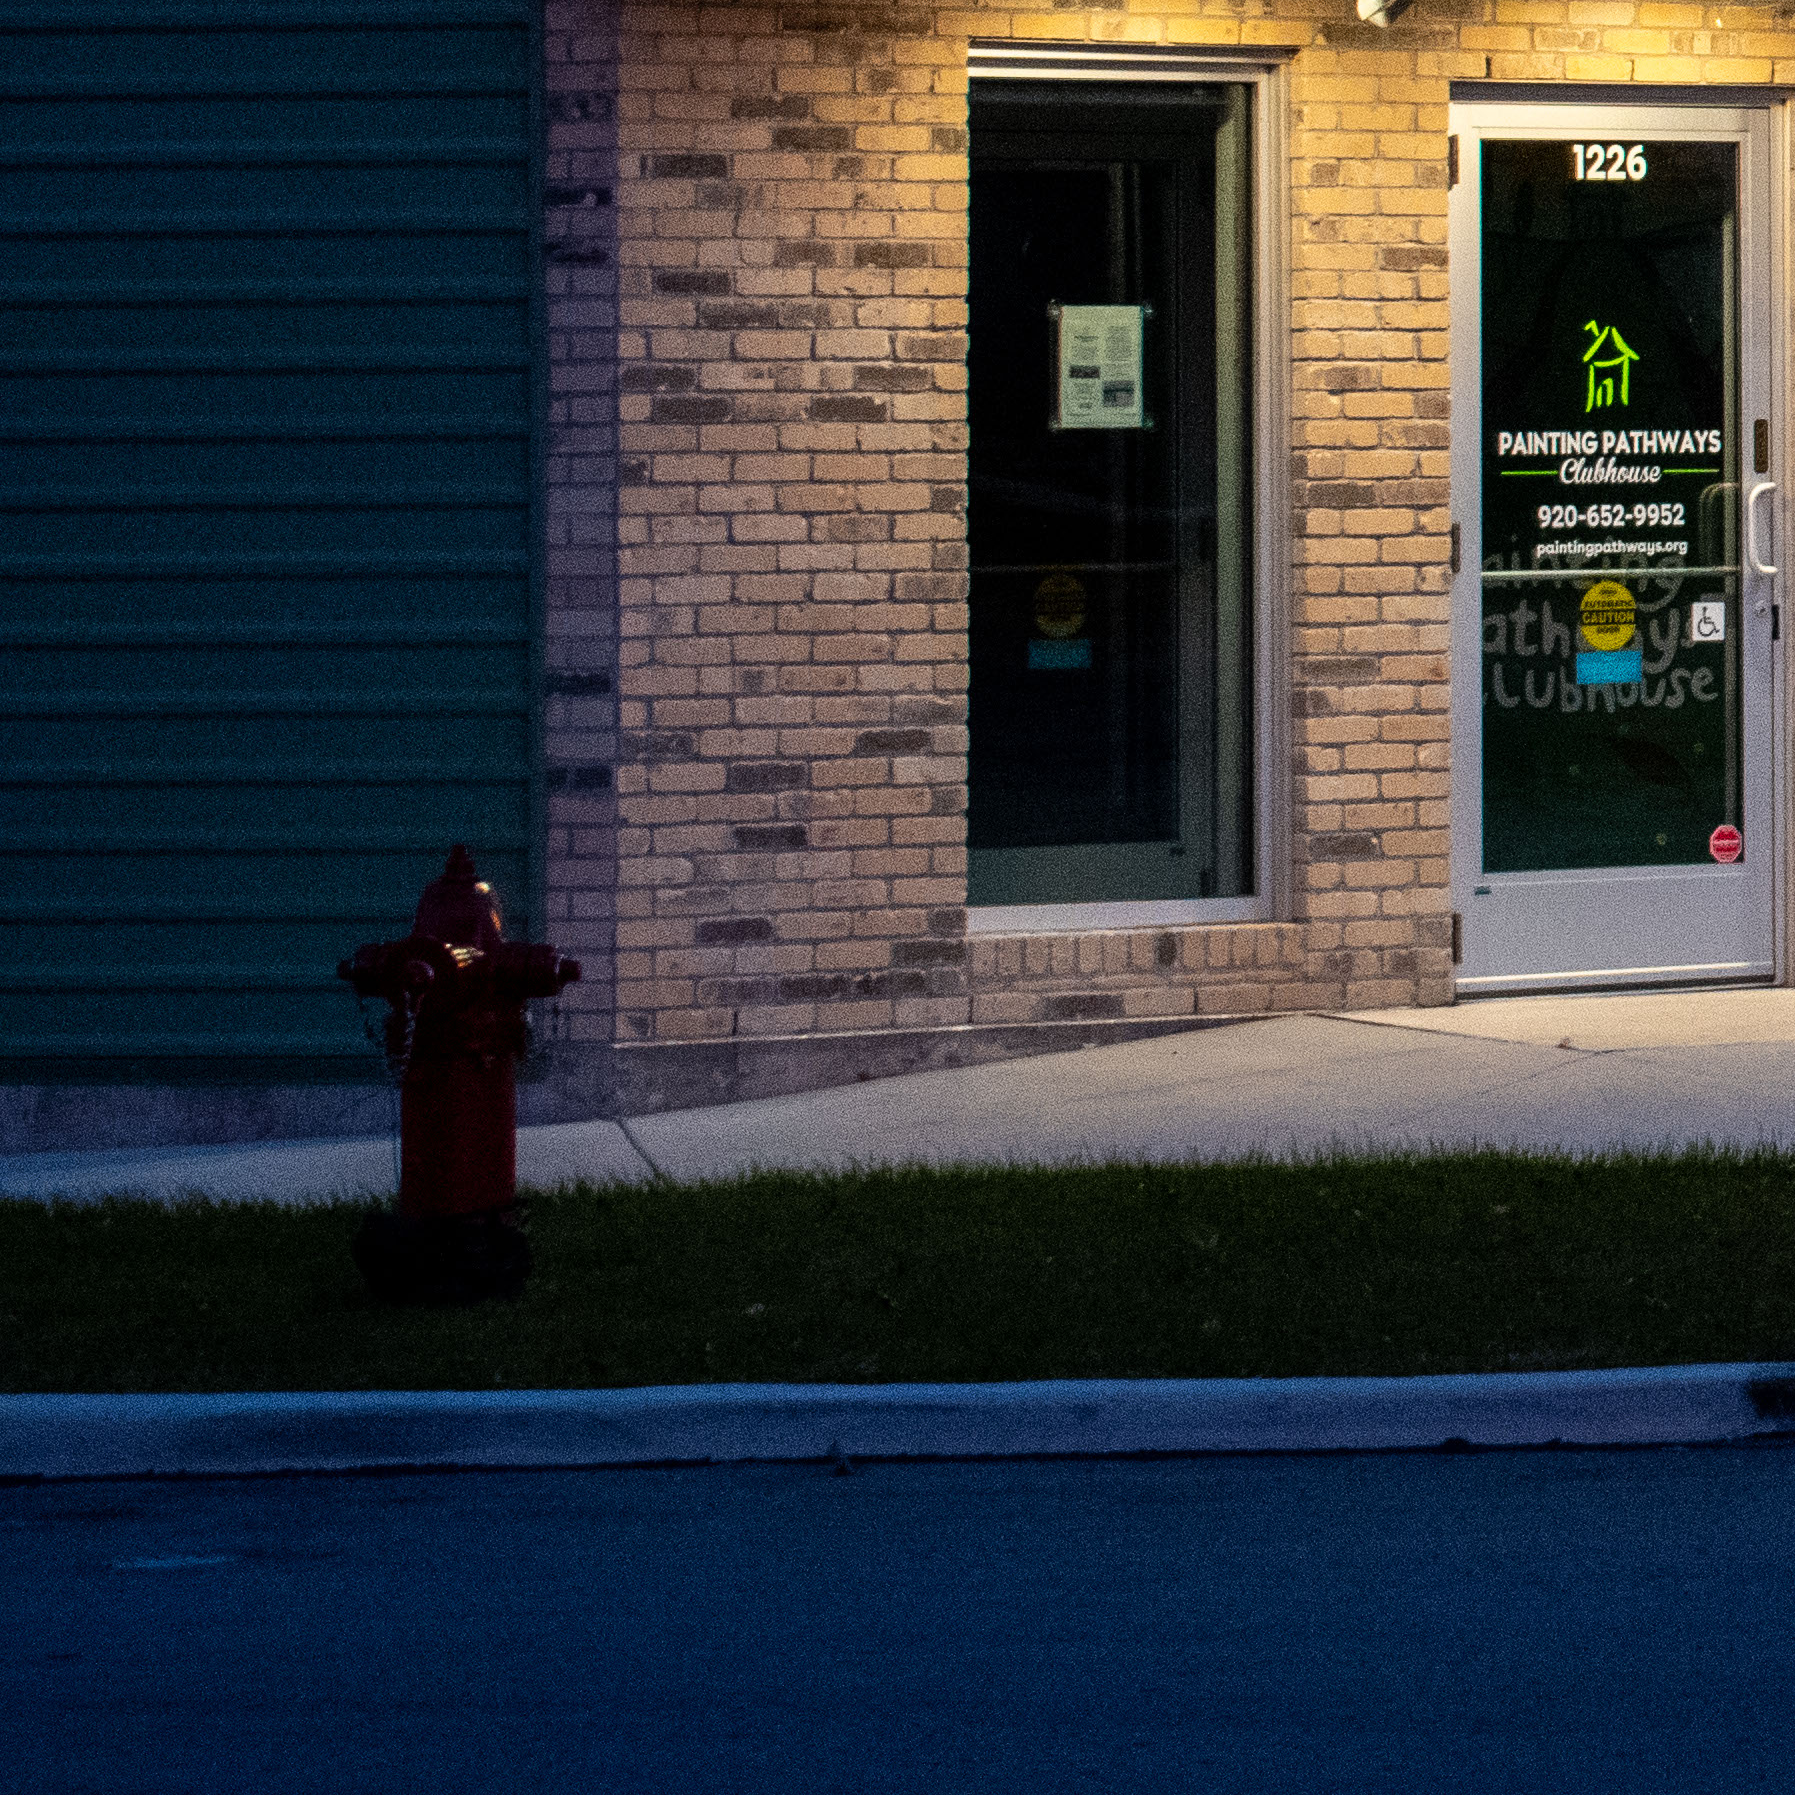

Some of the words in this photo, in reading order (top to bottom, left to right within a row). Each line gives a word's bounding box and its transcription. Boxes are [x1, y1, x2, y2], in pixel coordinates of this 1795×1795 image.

[1572, 143, 1649, 181] 1226
[1498, 431, 1599, 456] PAINTING
[1602, 430, 1722, 454] PATHWAYS
[1559, 456, 1662, 485] Clubhouse
[1537, 503, 1686, 528] 920-652-9952
[1536, 539, 1688, 558] paintingpathways.org
[1482, 535, 1686, 612] ainting
[1582, 610, 1636, 624] CAUTION
[1482, 598, 1697, 674] athy
[1483, 662, 1719, 714] lubhouse
